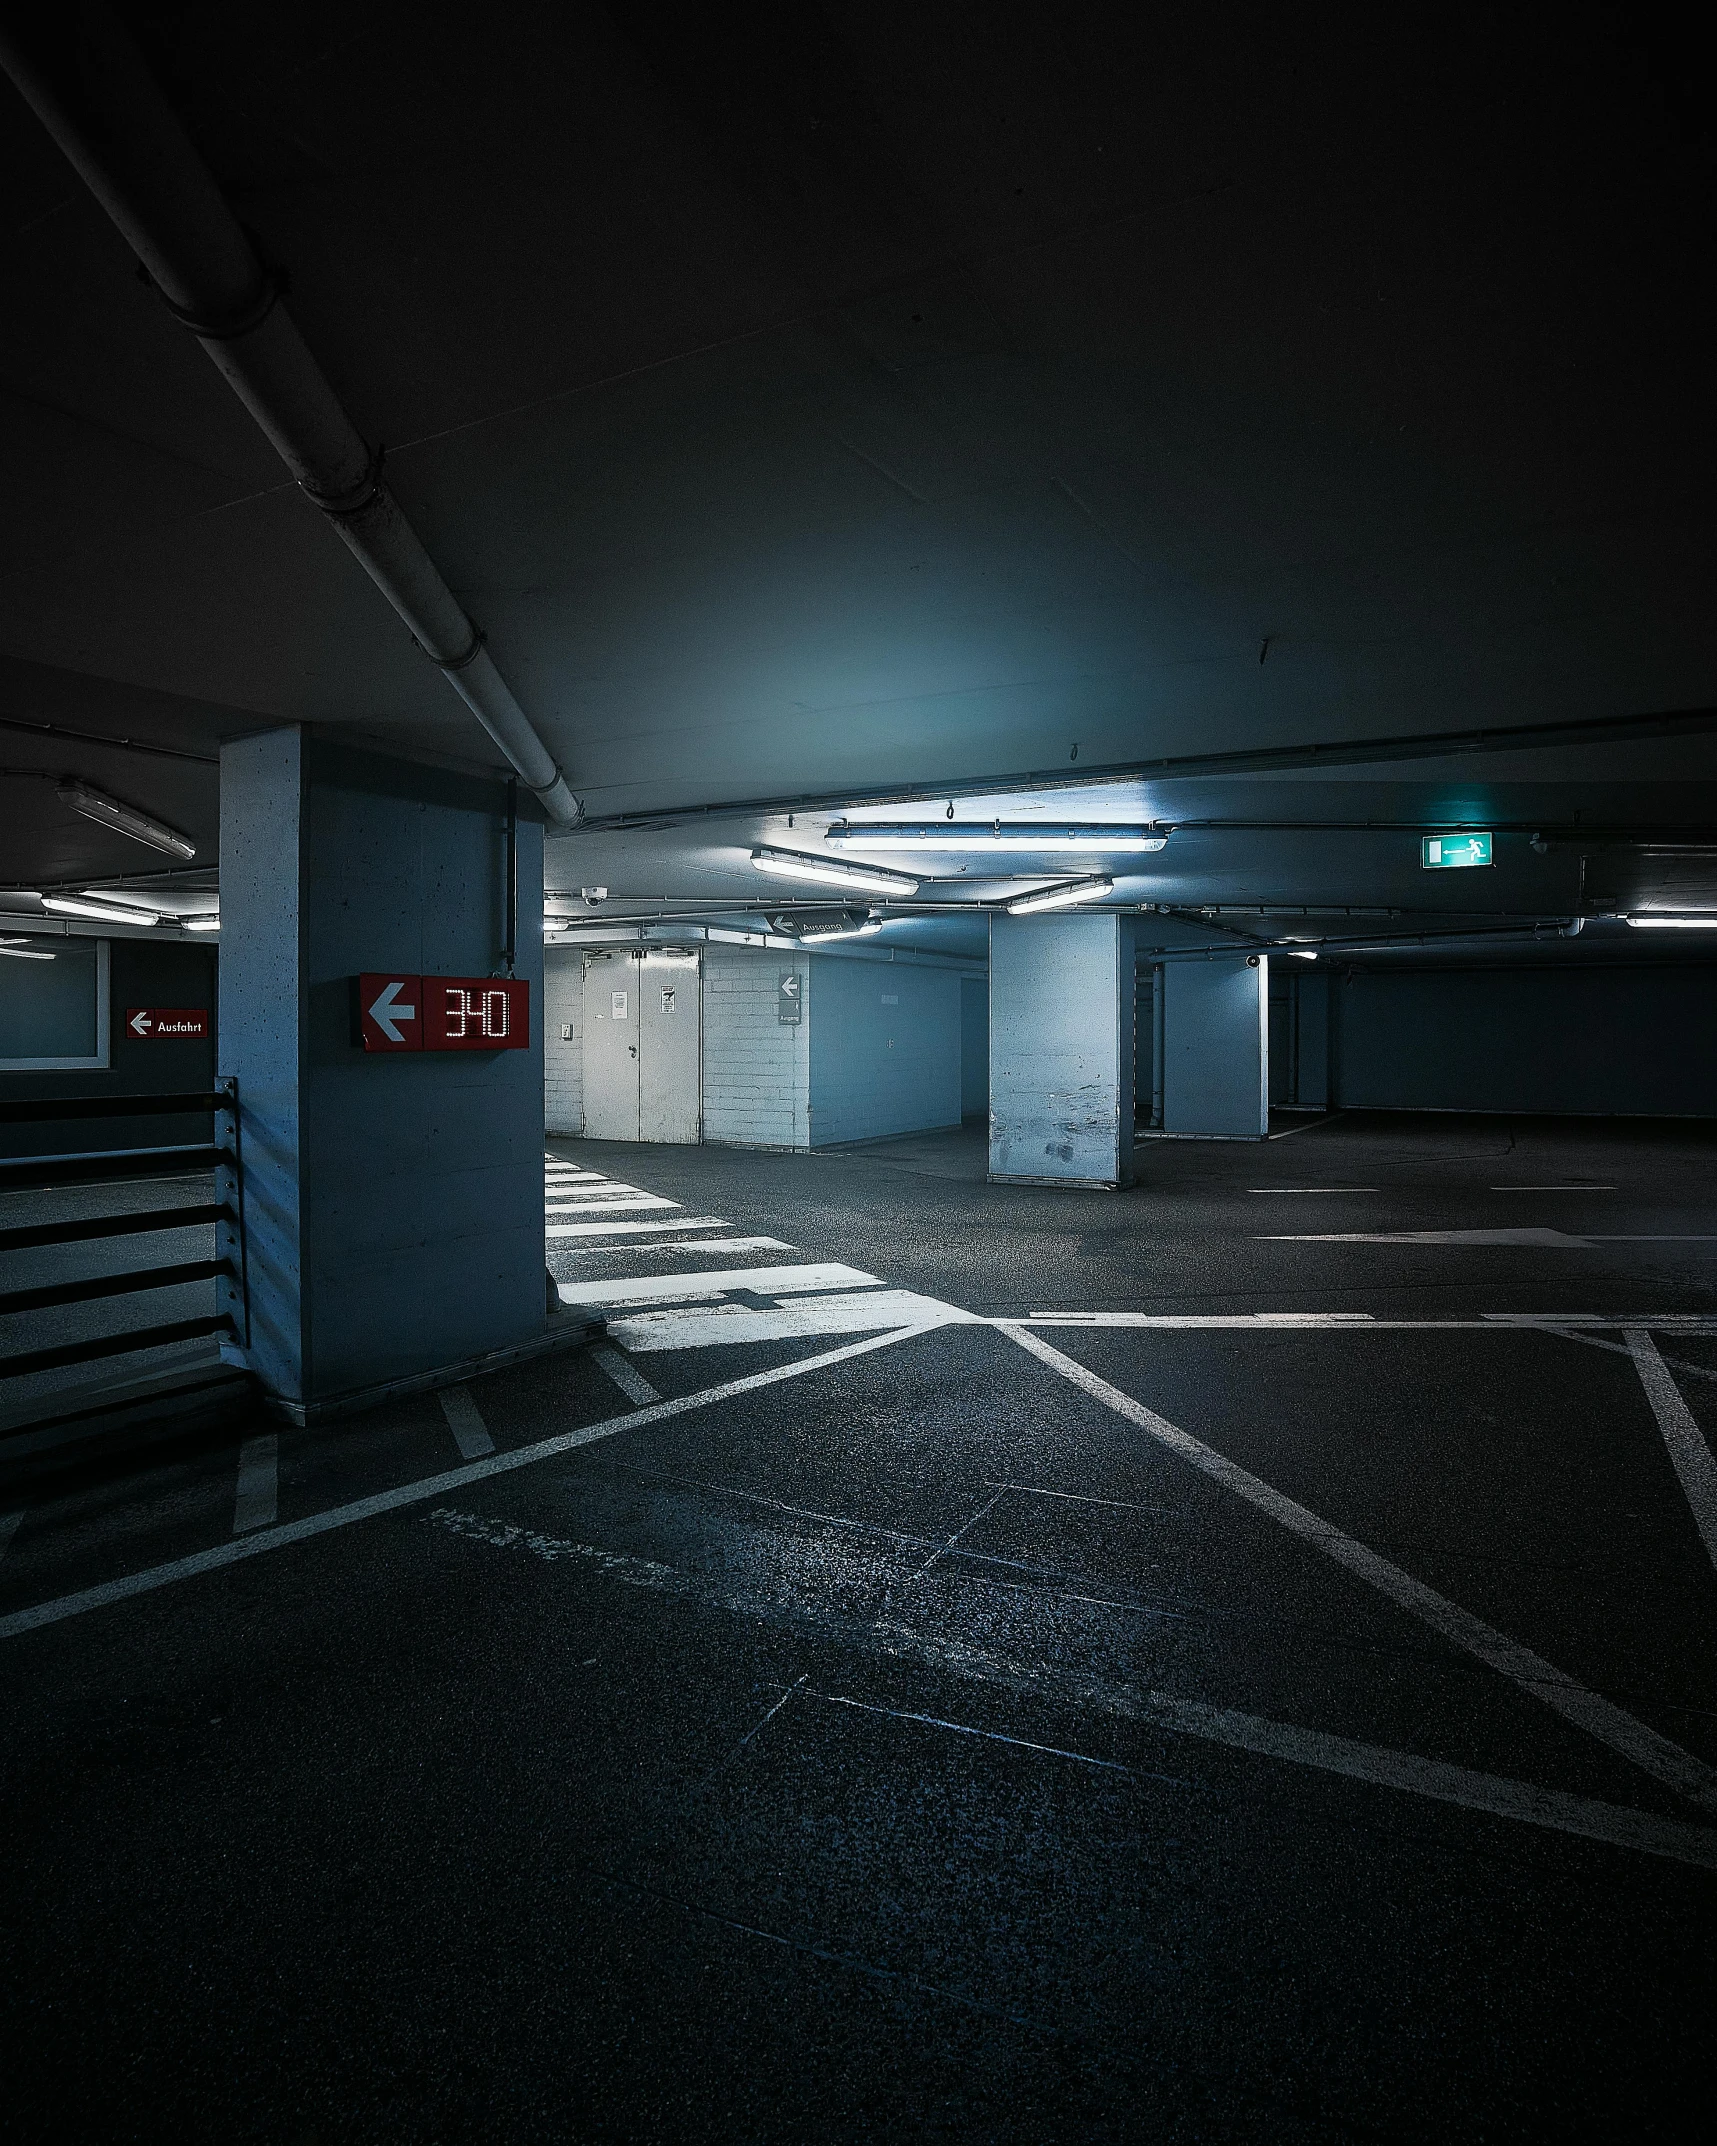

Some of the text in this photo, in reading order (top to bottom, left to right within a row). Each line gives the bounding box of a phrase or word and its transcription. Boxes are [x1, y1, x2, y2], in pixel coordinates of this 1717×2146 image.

[803, 923, 842, 931] Ausgang
[446, 988, 507, 1037] 340
[157, 1021, 202, 1032] Ausfahrt
